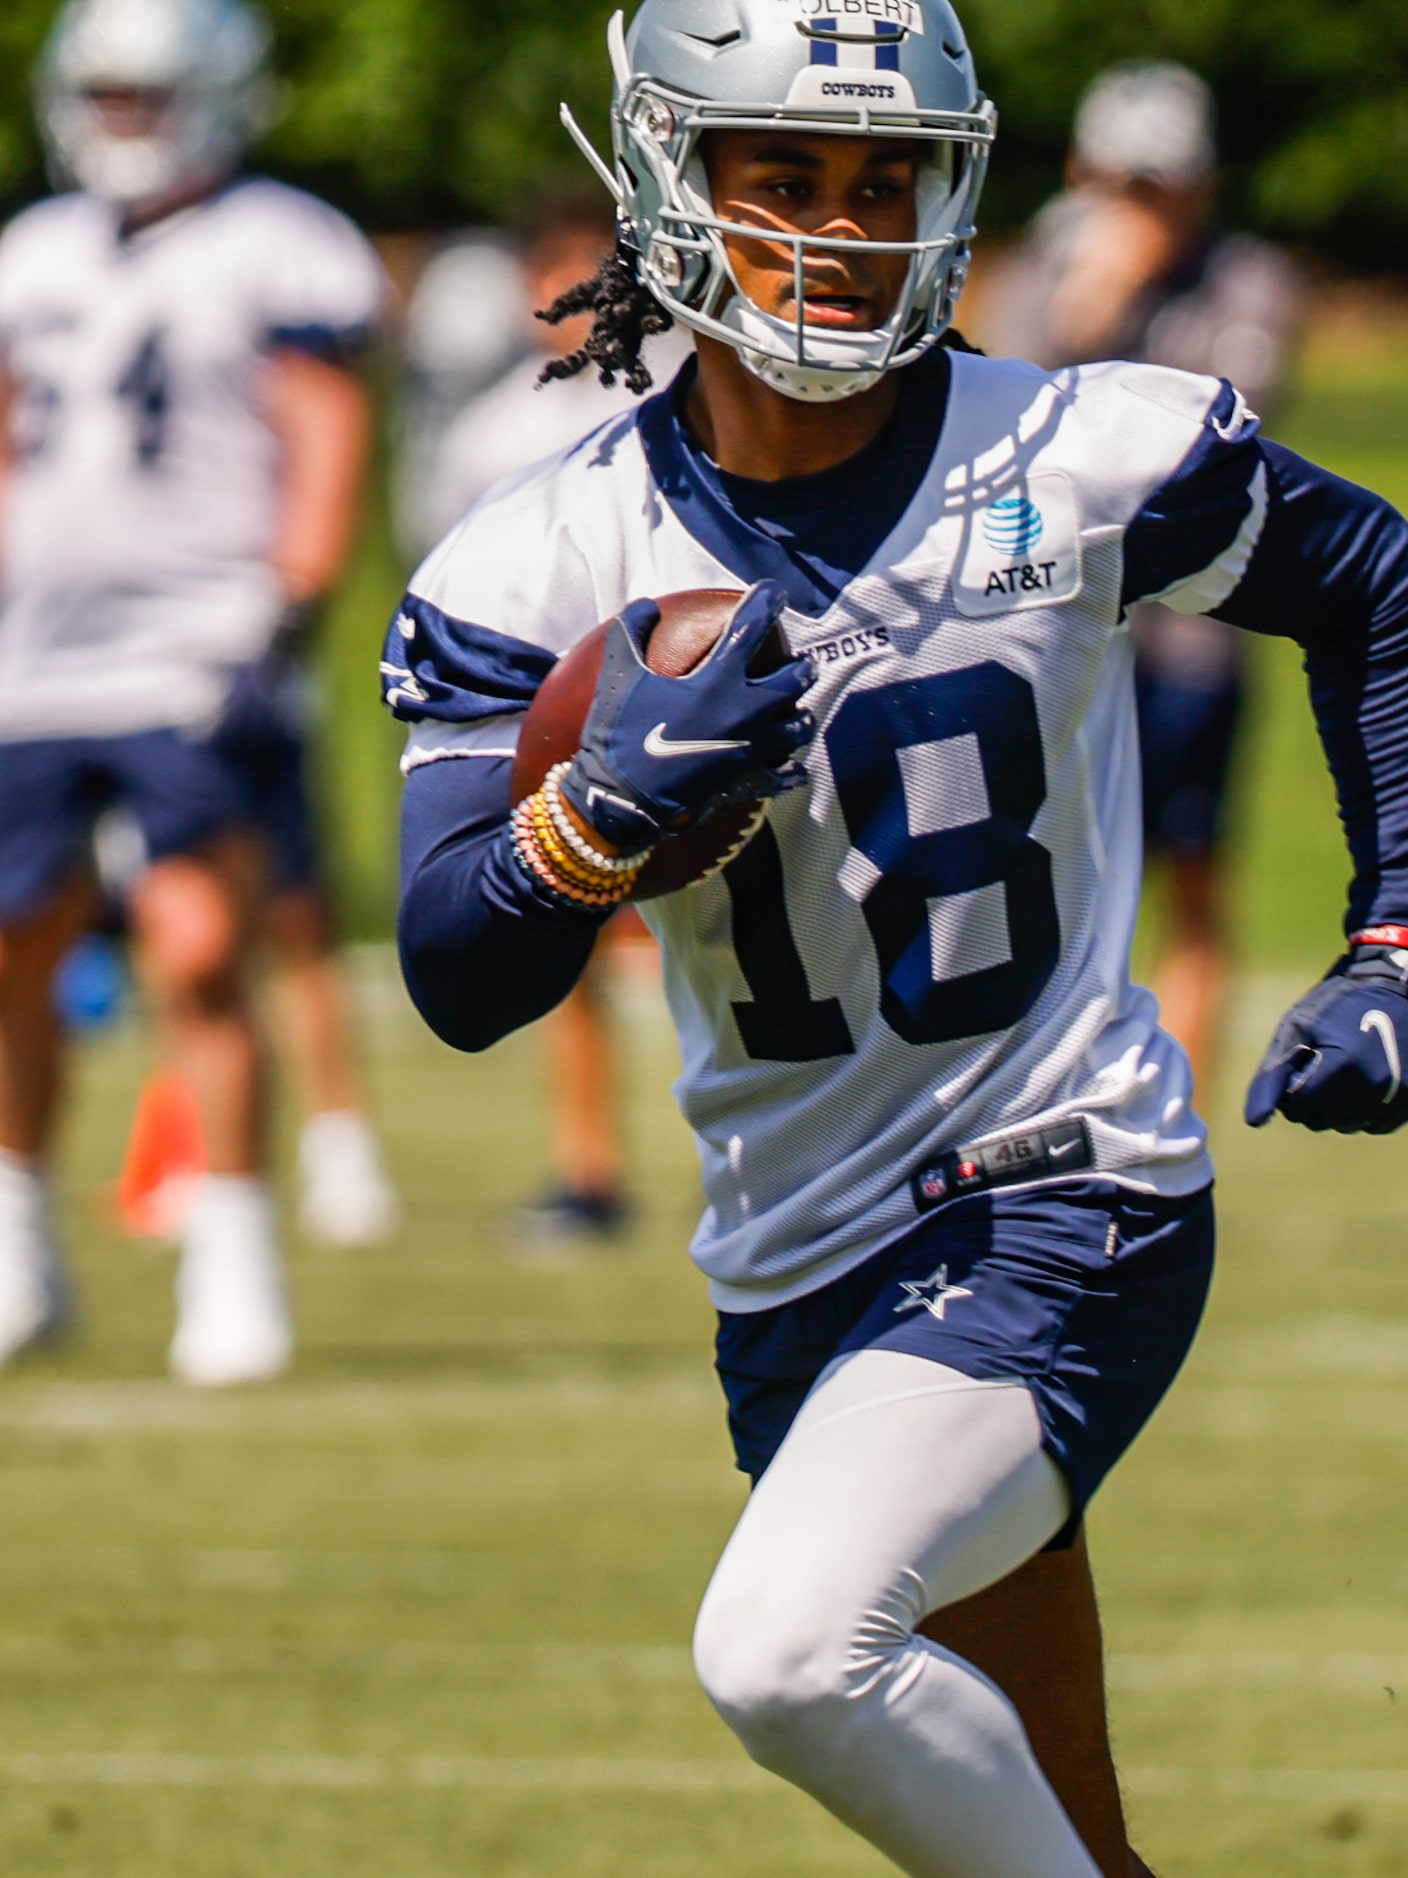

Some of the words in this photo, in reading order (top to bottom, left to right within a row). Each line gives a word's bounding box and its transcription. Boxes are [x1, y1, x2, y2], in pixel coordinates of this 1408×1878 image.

[780, 0, 914, 25] OLBERT
[822, 82, 895, 99] COWBOYS
[984, 561, 1056, 597] AT&T
[722, 659, 1061, 1063] 18
